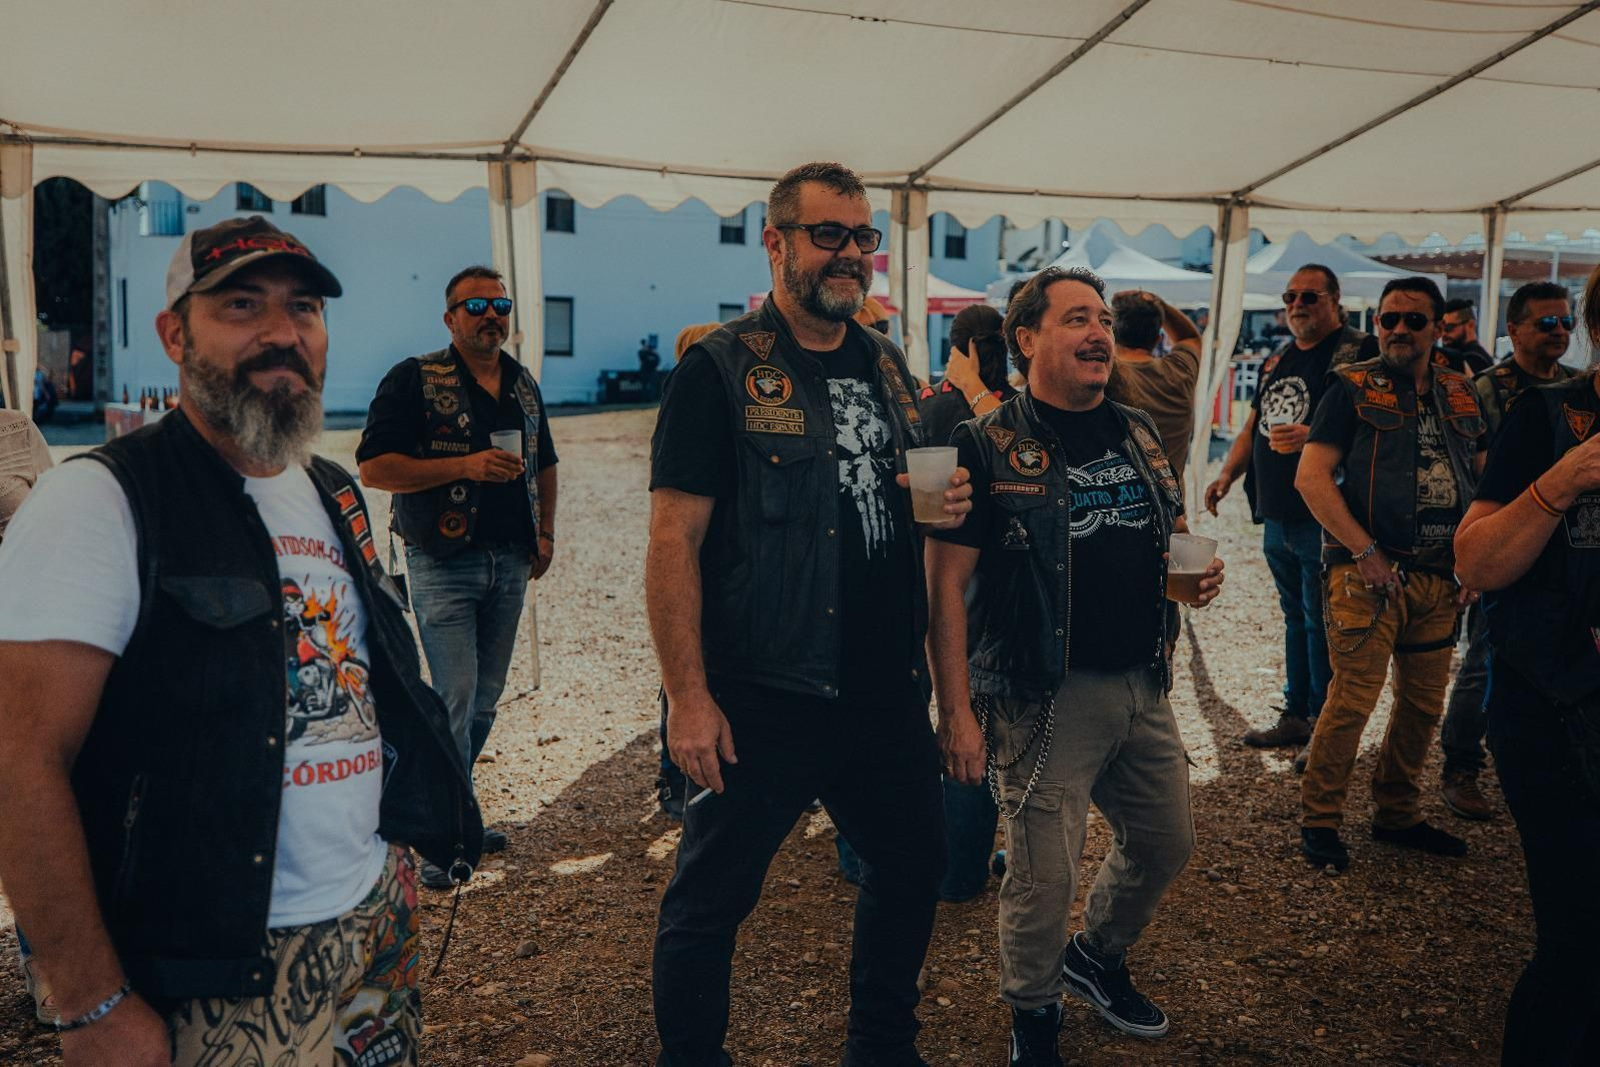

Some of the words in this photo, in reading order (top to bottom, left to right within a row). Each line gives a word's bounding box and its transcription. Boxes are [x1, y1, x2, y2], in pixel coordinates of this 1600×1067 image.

[756, 369, 781, 380] HDC
[749, 408, 801, 419] PRESIDENTE
[749, 420, 768, 430] HDC
[769, 421, 801, 432] ESPAÑA
[1018, 442, 1041, 452] HDC
